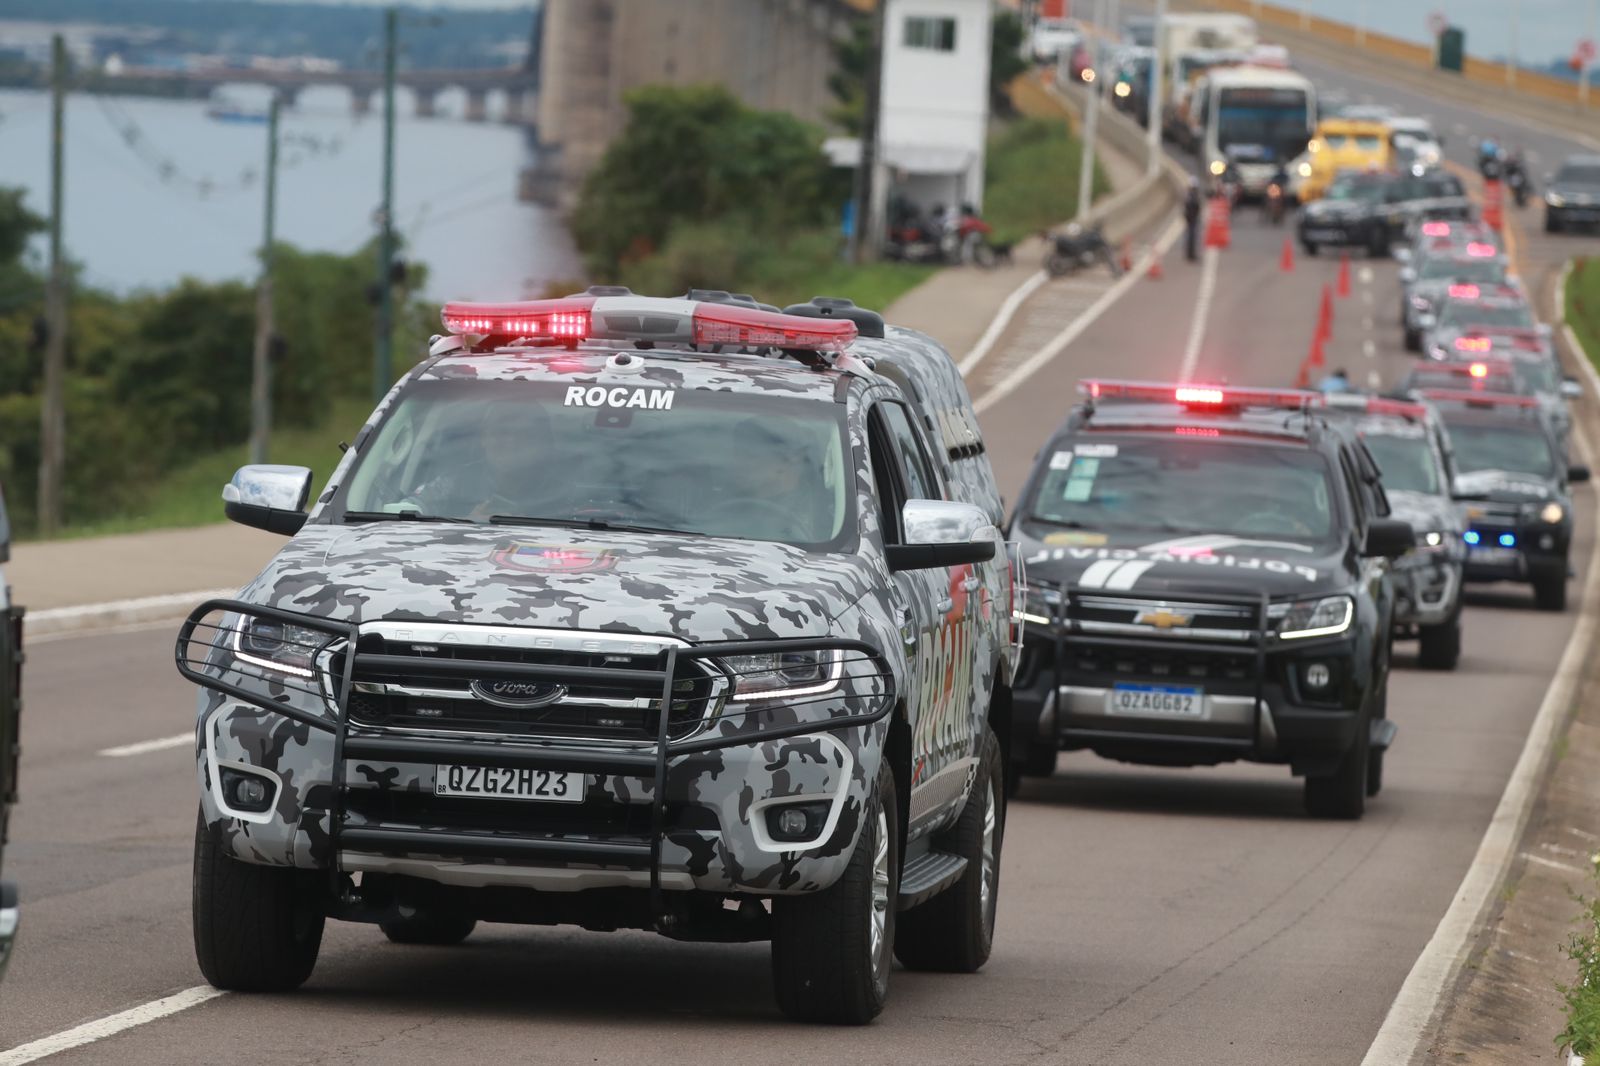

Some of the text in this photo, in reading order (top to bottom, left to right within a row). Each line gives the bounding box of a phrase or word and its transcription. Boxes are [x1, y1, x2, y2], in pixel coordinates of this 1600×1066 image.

[564, 386, 675, 410] ROCAM
[394, 629, 650, 653] RANGER
[438, 784, 447, 793] BR
[449, 764, 568, 796] QZG2H23
